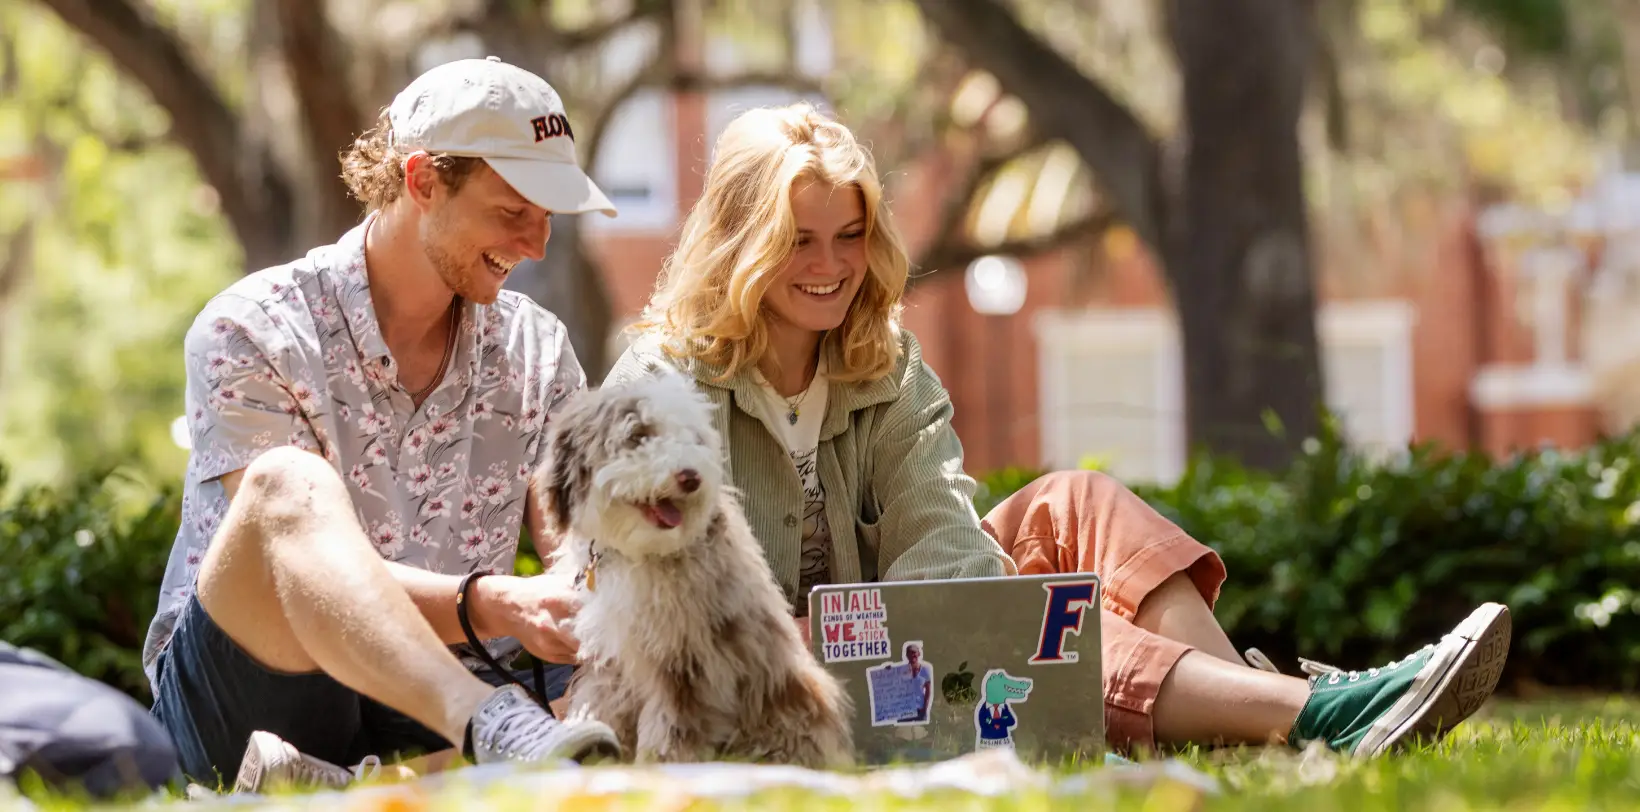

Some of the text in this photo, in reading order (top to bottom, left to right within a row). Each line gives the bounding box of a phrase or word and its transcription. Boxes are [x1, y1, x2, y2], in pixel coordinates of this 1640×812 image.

[824, 592, 882, 613] IN ALL
[856, 612, 884, 620] WEATHER
[1032, 582, 1095, 661] F
[825, 620, 879, 643] WE ALL
[859, 631, 884, 641] STICK
[826, 641, 887, 658] TOGETHER
